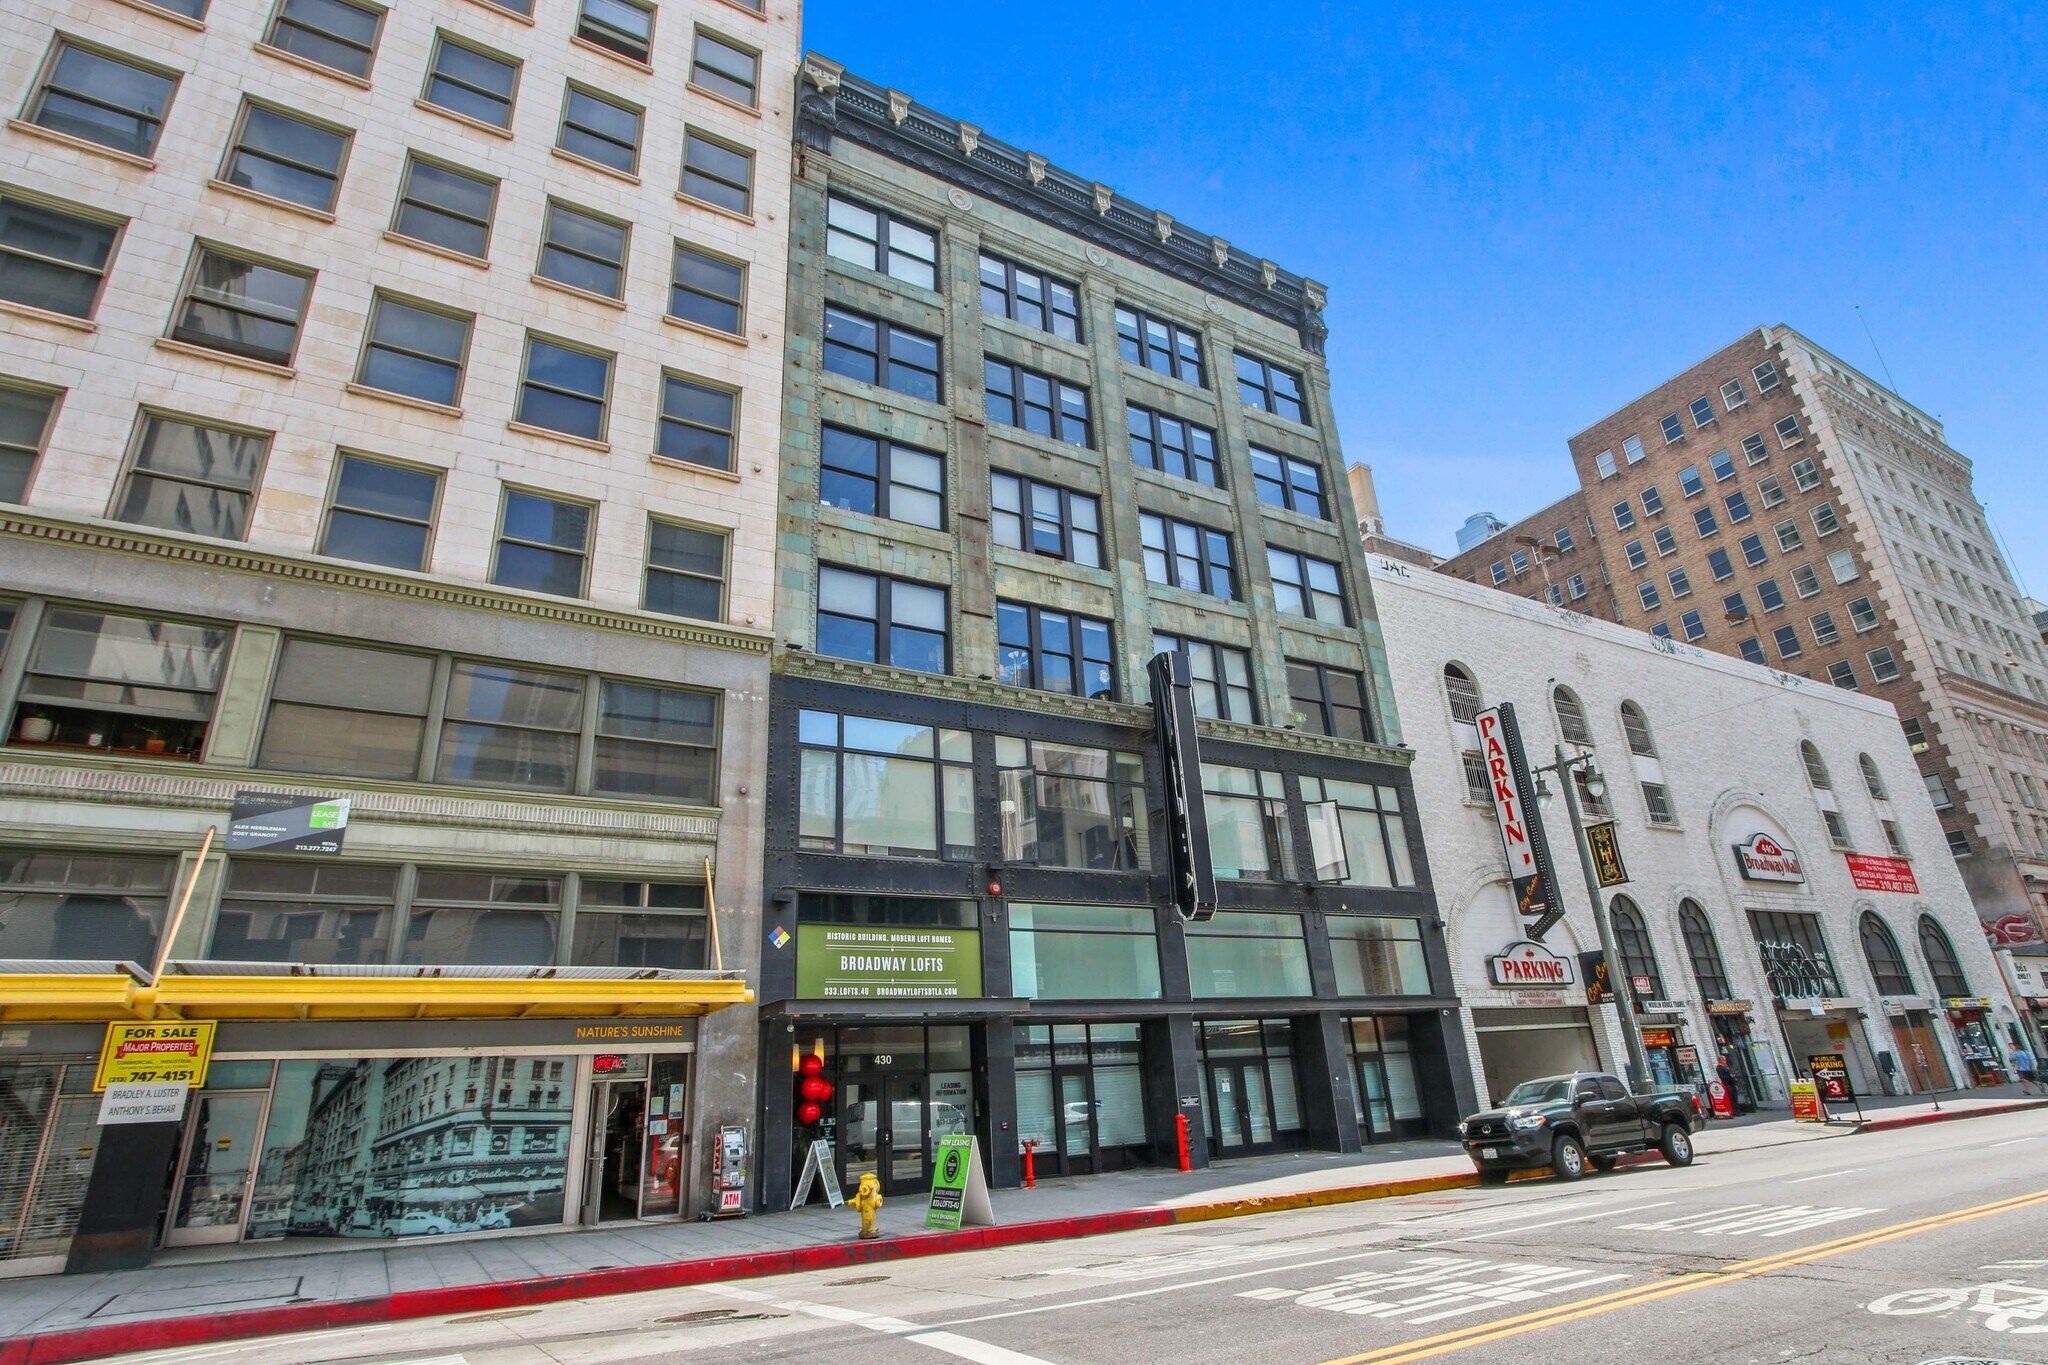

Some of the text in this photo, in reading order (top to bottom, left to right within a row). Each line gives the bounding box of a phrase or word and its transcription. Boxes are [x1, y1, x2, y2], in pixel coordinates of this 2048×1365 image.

[1479, 716, 1531, 865] PARKIN
[312, 811, 338, 819] LEASE
[1762, 845, 1775, 854] 440
[1743, 853, 1801, 876] Broadway Mall
[827, 932, 856, 941] HISTORIC
[858, 933, 889, 942] BUILDING.
[891, 934, 915, 942] MODERN
[917, 935, 930, 943] LOFT
[841, 956, 943, 972] BROADWAY LOFTS
[1502, 960, 1563, 979] PARKING
[824, 987, 957, 996] 833.LOFTS.4U BROADWAYLOFTSDTLA.COM
[125, 1028, 198, 1038] FOR SALE
[576, 1025, 683, 1038] NATURE'S SUNSHINE
[123, 1042, 194, 1052] MAJOR PROPERTIES
[874, 1055, 892, 1065] 430
[1811, 1061, 1844, 1069] PARKING
[130, 1070, 195, 1082] 747-4151
[112, 1090, 145, 1100] BRADLEY
[153, 1088, 180, 1098] LUSTER
[673, 1086, 681, 1094] A
[108, 1106, 144, 1116] ANTHONY
[152, 1104, 176, 1114] BEHAR
[724, 1193, 739, 1205] ATM
